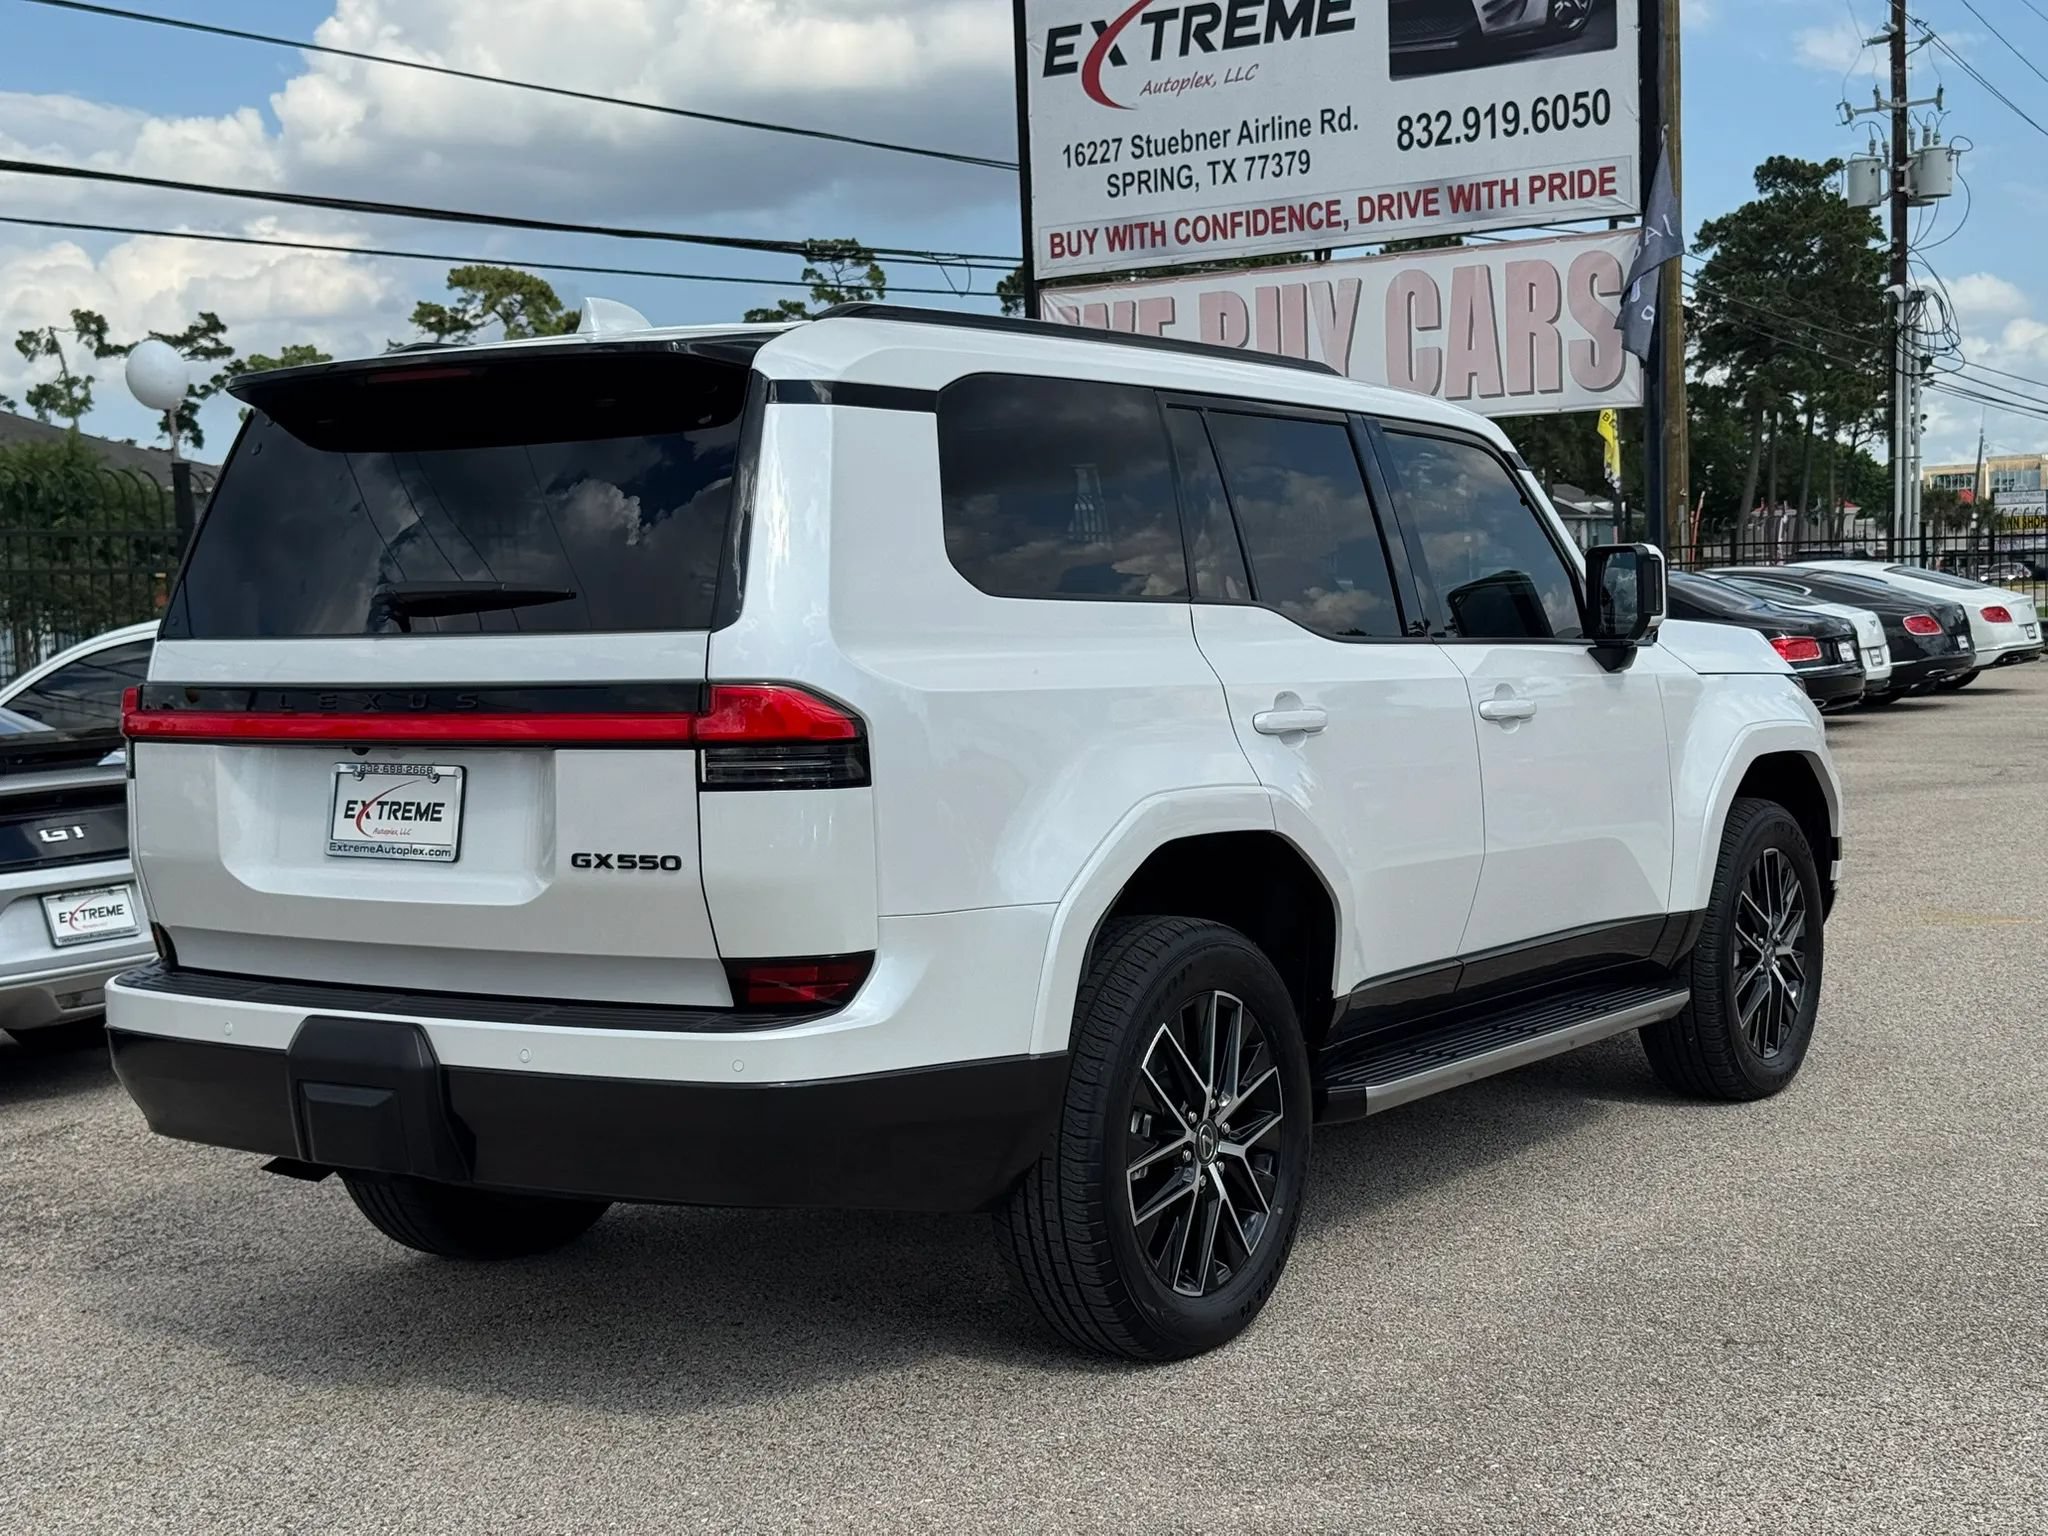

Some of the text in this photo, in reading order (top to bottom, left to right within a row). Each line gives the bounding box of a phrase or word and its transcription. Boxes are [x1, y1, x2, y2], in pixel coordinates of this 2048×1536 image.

[1043, 0, 1356, 77] EXTREME
[1140, 64, 1259, 97] Autoplex, LLC
[1062, 106, 1359, 168] 16227 Stuebner Airline Rd.
[1397, 88, 1611, 151] 832.919.6050
[1107, 149, 1312, 198] SPRING, TX 77379
[1049, 165, 1617, 259] BUY WITH CONFIDENCE, DRIVE WITH PRIDE
[1385, 250, 1627, 400] CARS
[278, 693, 480, 711] LEXUS
[343, 800, 446, 822] EXTREME
[39, 824, 88, 843] GT
[329, 842, 452, 857] ExtremeAutoplex.com
[58, 904, 125, 924] EXTREME
